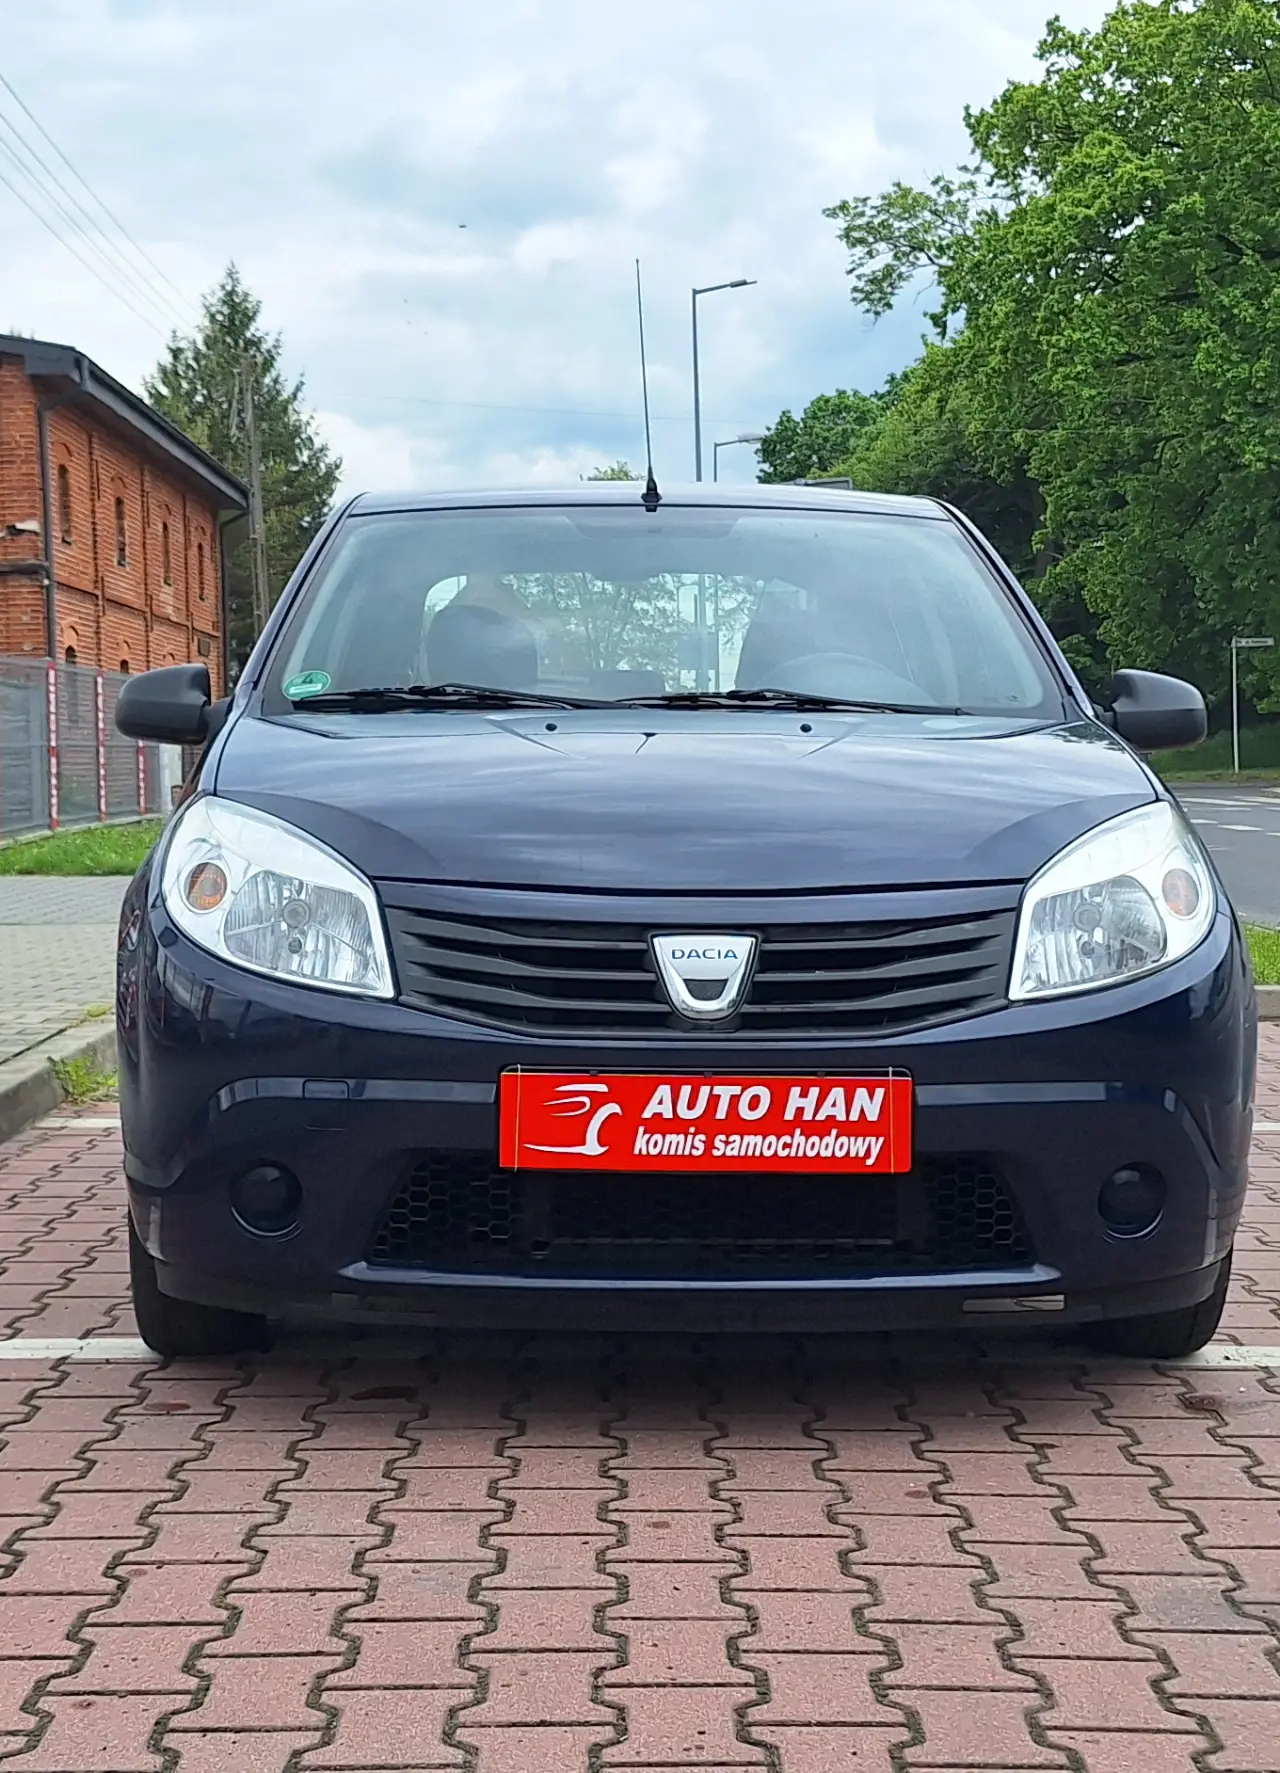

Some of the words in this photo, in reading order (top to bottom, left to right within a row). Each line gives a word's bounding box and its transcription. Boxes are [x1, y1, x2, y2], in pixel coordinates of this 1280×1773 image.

[671, 949, 738, 960] DACIA
[641, 1084, 770, 1119] AUTO
[783, 1086, 885, 1122] HAN
[633, 1126, 706, 1157] komis
[712, 1129, 884, 1166] samochodowy
